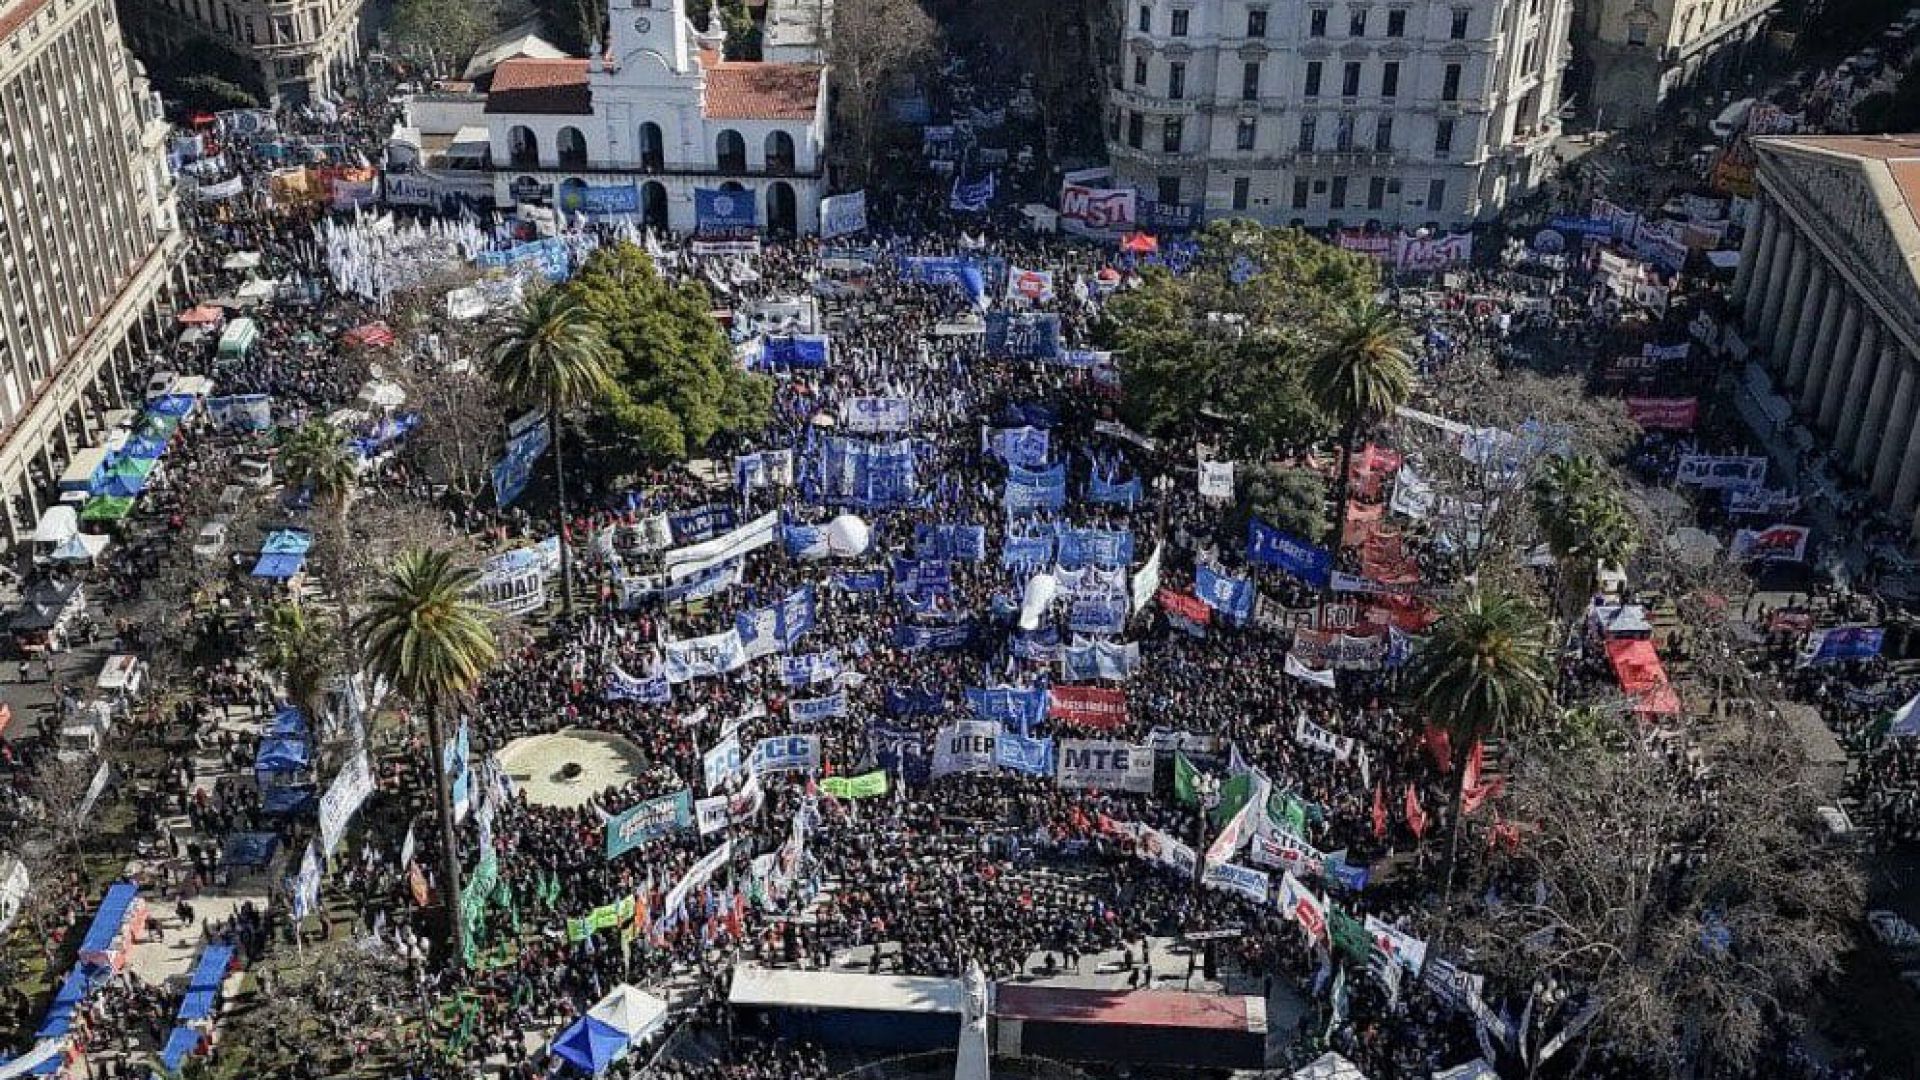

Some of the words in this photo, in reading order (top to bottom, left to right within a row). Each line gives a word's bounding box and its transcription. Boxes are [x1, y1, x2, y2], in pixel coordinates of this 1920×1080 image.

[1061, 188, 1127, 227] MST
[951, 735, 994, 754] UTEP
[1065, 749, 1129, 770] MTE
